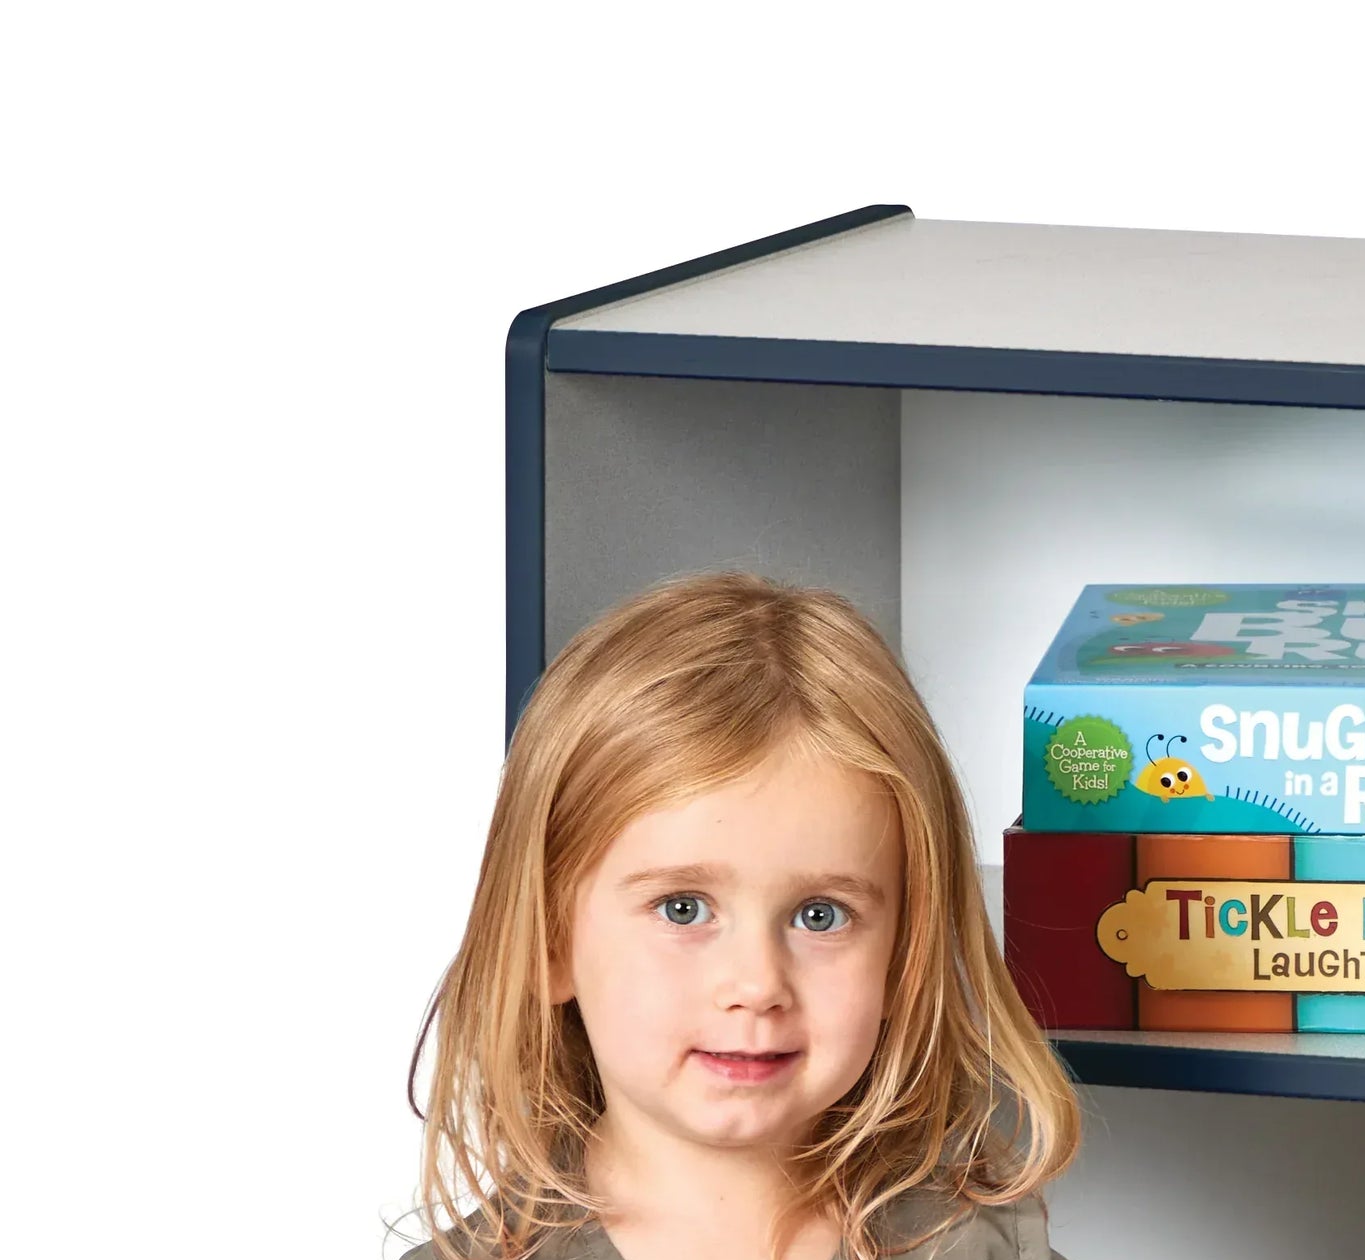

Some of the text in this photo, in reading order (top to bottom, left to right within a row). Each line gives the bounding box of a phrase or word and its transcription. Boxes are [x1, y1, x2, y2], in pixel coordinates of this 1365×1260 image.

[1073, 731, 1088, 746] A
[1050, 744, 1129, 761] Cooperative
[1059, 760, 1117, 773] Game for
[1072, 773, 1109, 790] Kids!
[1285, 770, 1313, 796] in
[1319, 771, 1338, 796] a
